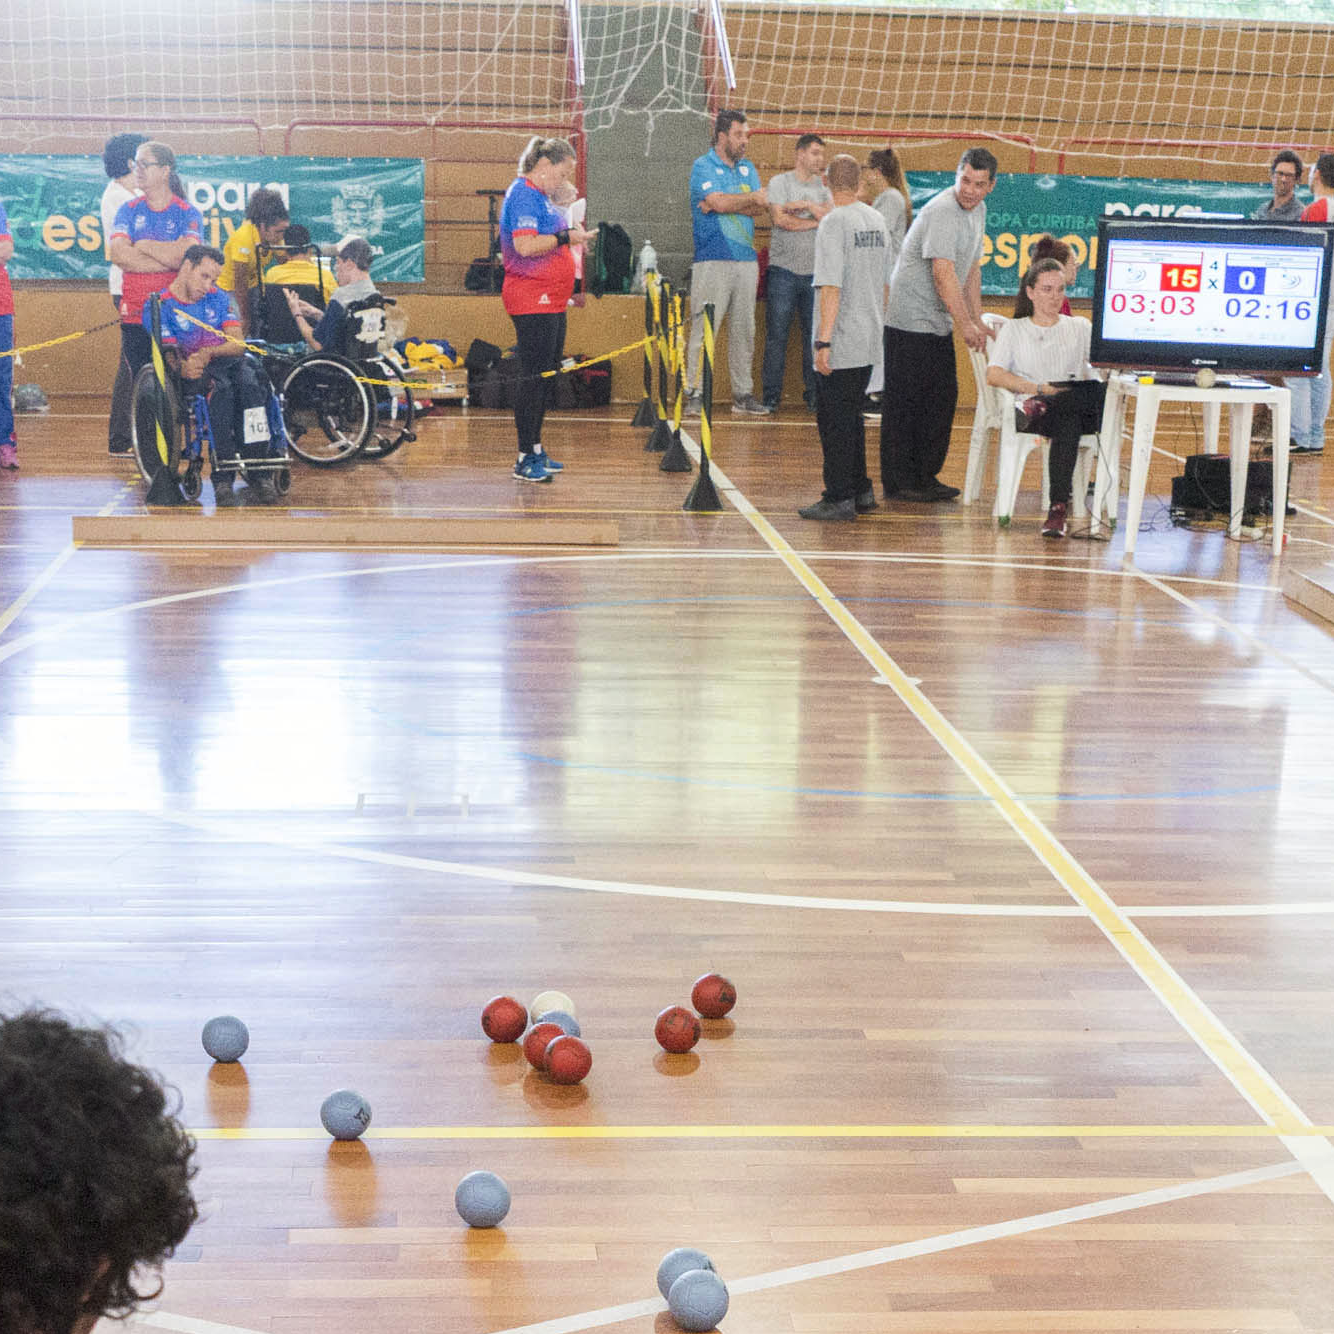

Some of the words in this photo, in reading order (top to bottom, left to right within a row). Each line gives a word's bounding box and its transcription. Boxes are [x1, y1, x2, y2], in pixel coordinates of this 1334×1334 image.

[1209, 260, 1219, 271] 4
[1166, 267, 1199, 288] 15
[1237, 271, 1256, 290] 0
[1110, 293, 1196, 317] 03:03
[1225, 297, 1312, 321] 02:16
